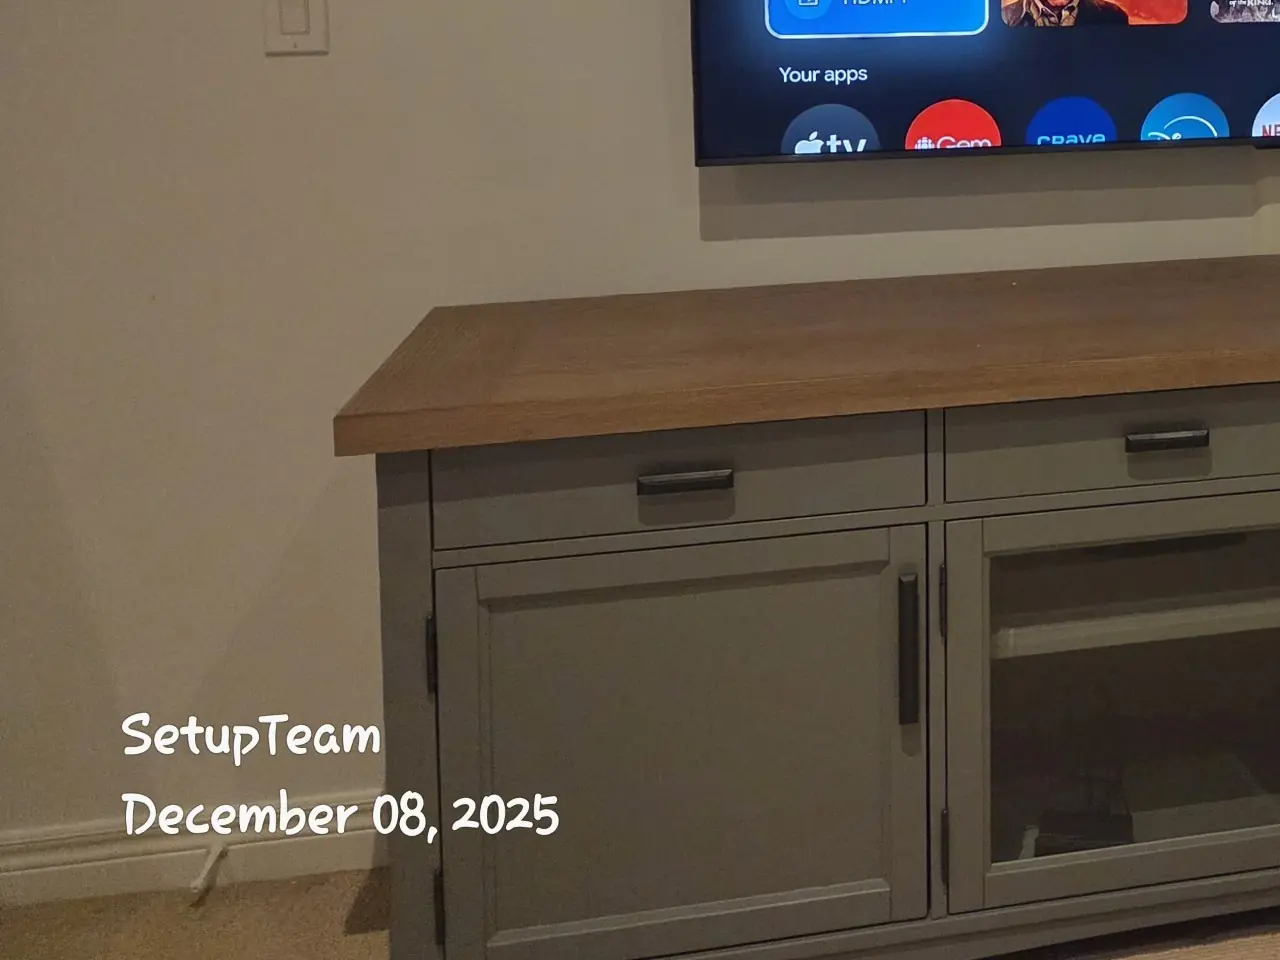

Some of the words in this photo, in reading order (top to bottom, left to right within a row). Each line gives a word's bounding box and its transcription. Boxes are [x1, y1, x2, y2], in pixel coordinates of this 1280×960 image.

[778, 66, 821, 83] Your
[824, 68, 868, 86] apps
[826, 134, 867, 153] tv
